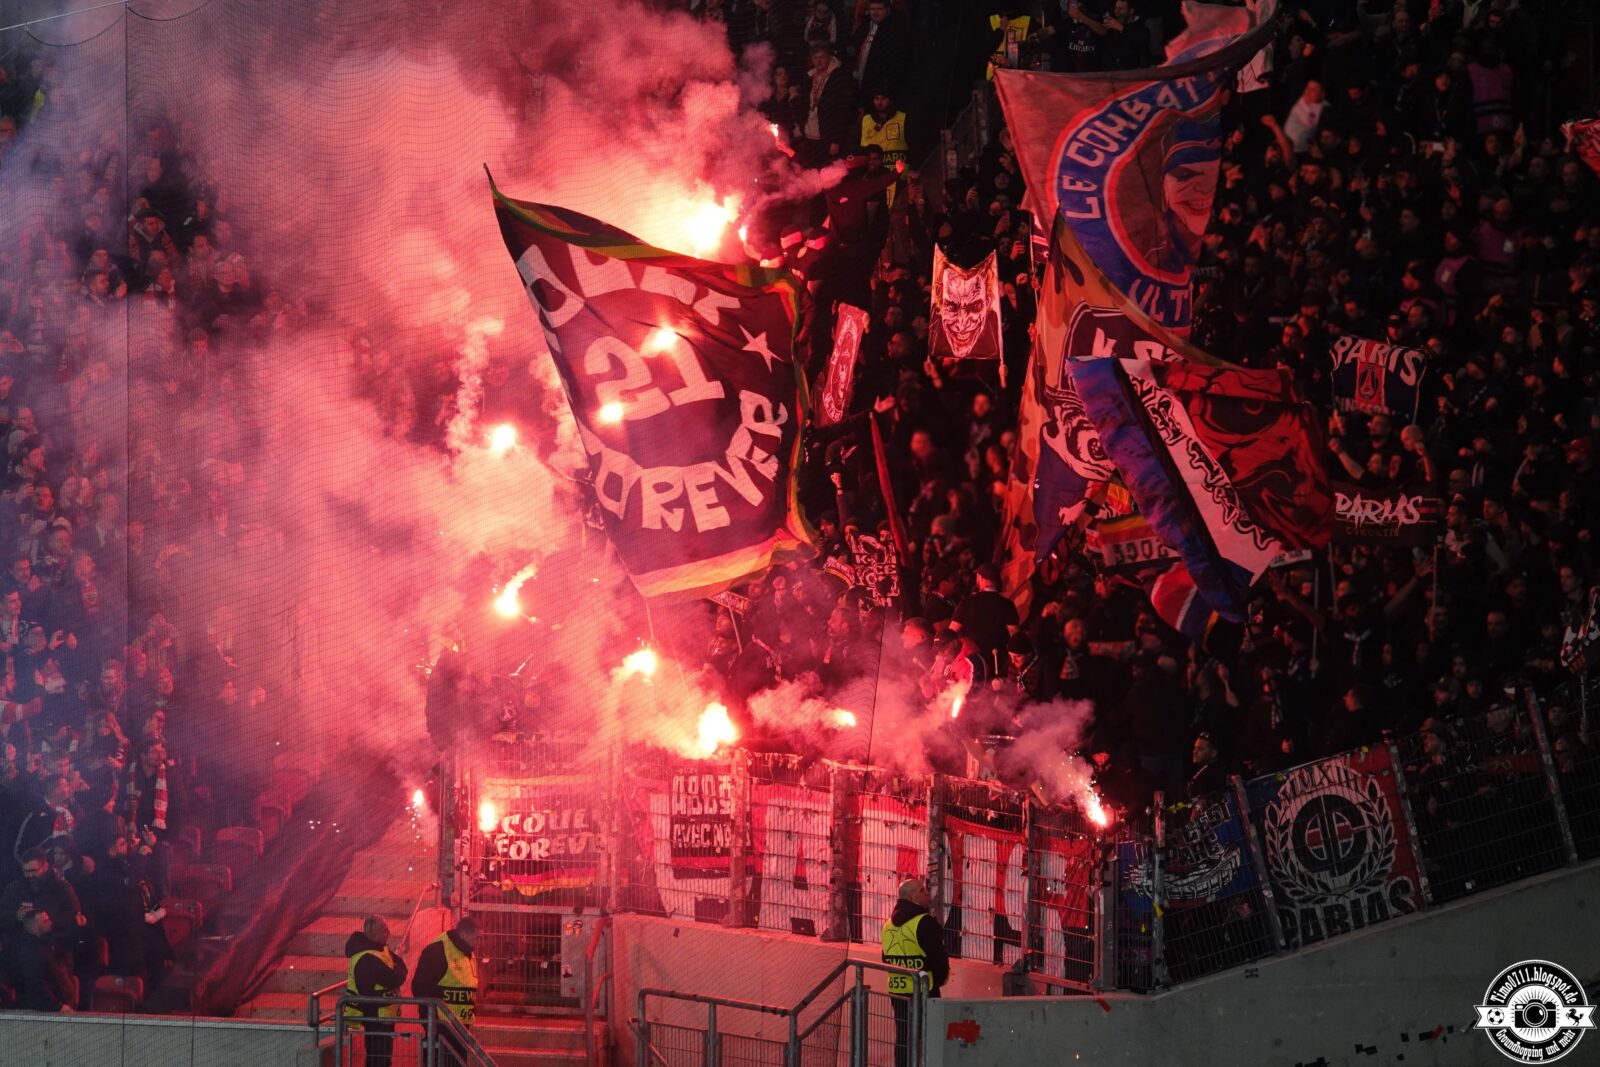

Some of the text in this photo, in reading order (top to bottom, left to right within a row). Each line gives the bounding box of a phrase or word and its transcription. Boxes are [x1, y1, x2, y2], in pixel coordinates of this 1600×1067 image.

[882, 151, 907, 164] ARD
[1063, 174, 1101, 220] LE
[583, 329, 725, 422] 21
[1331, 336, 1424, 387] PARIS
[1334, 491, 1423, 528] PARIAS
[1278, 878, 1412, 948] PARIAS
